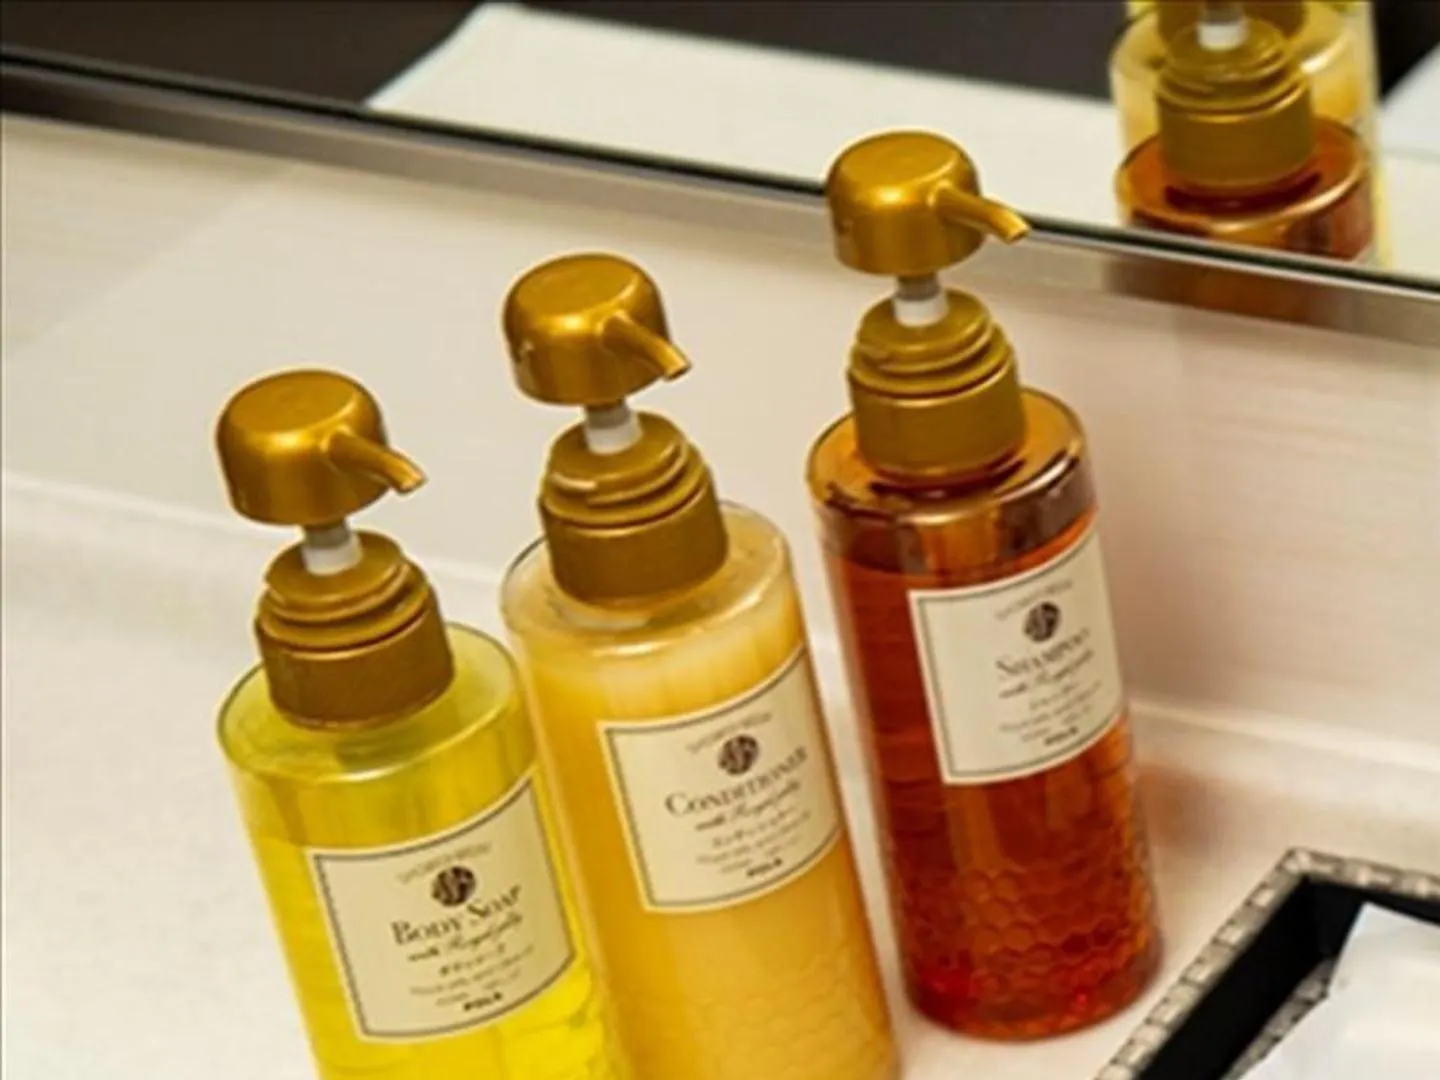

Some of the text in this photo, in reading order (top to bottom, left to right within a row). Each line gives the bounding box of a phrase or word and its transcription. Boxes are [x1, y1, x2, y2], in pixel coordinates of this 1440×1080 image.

[664, 746, 808, 816] CONDITIONER
[390, 884, 523, 946] BODY SOAP
